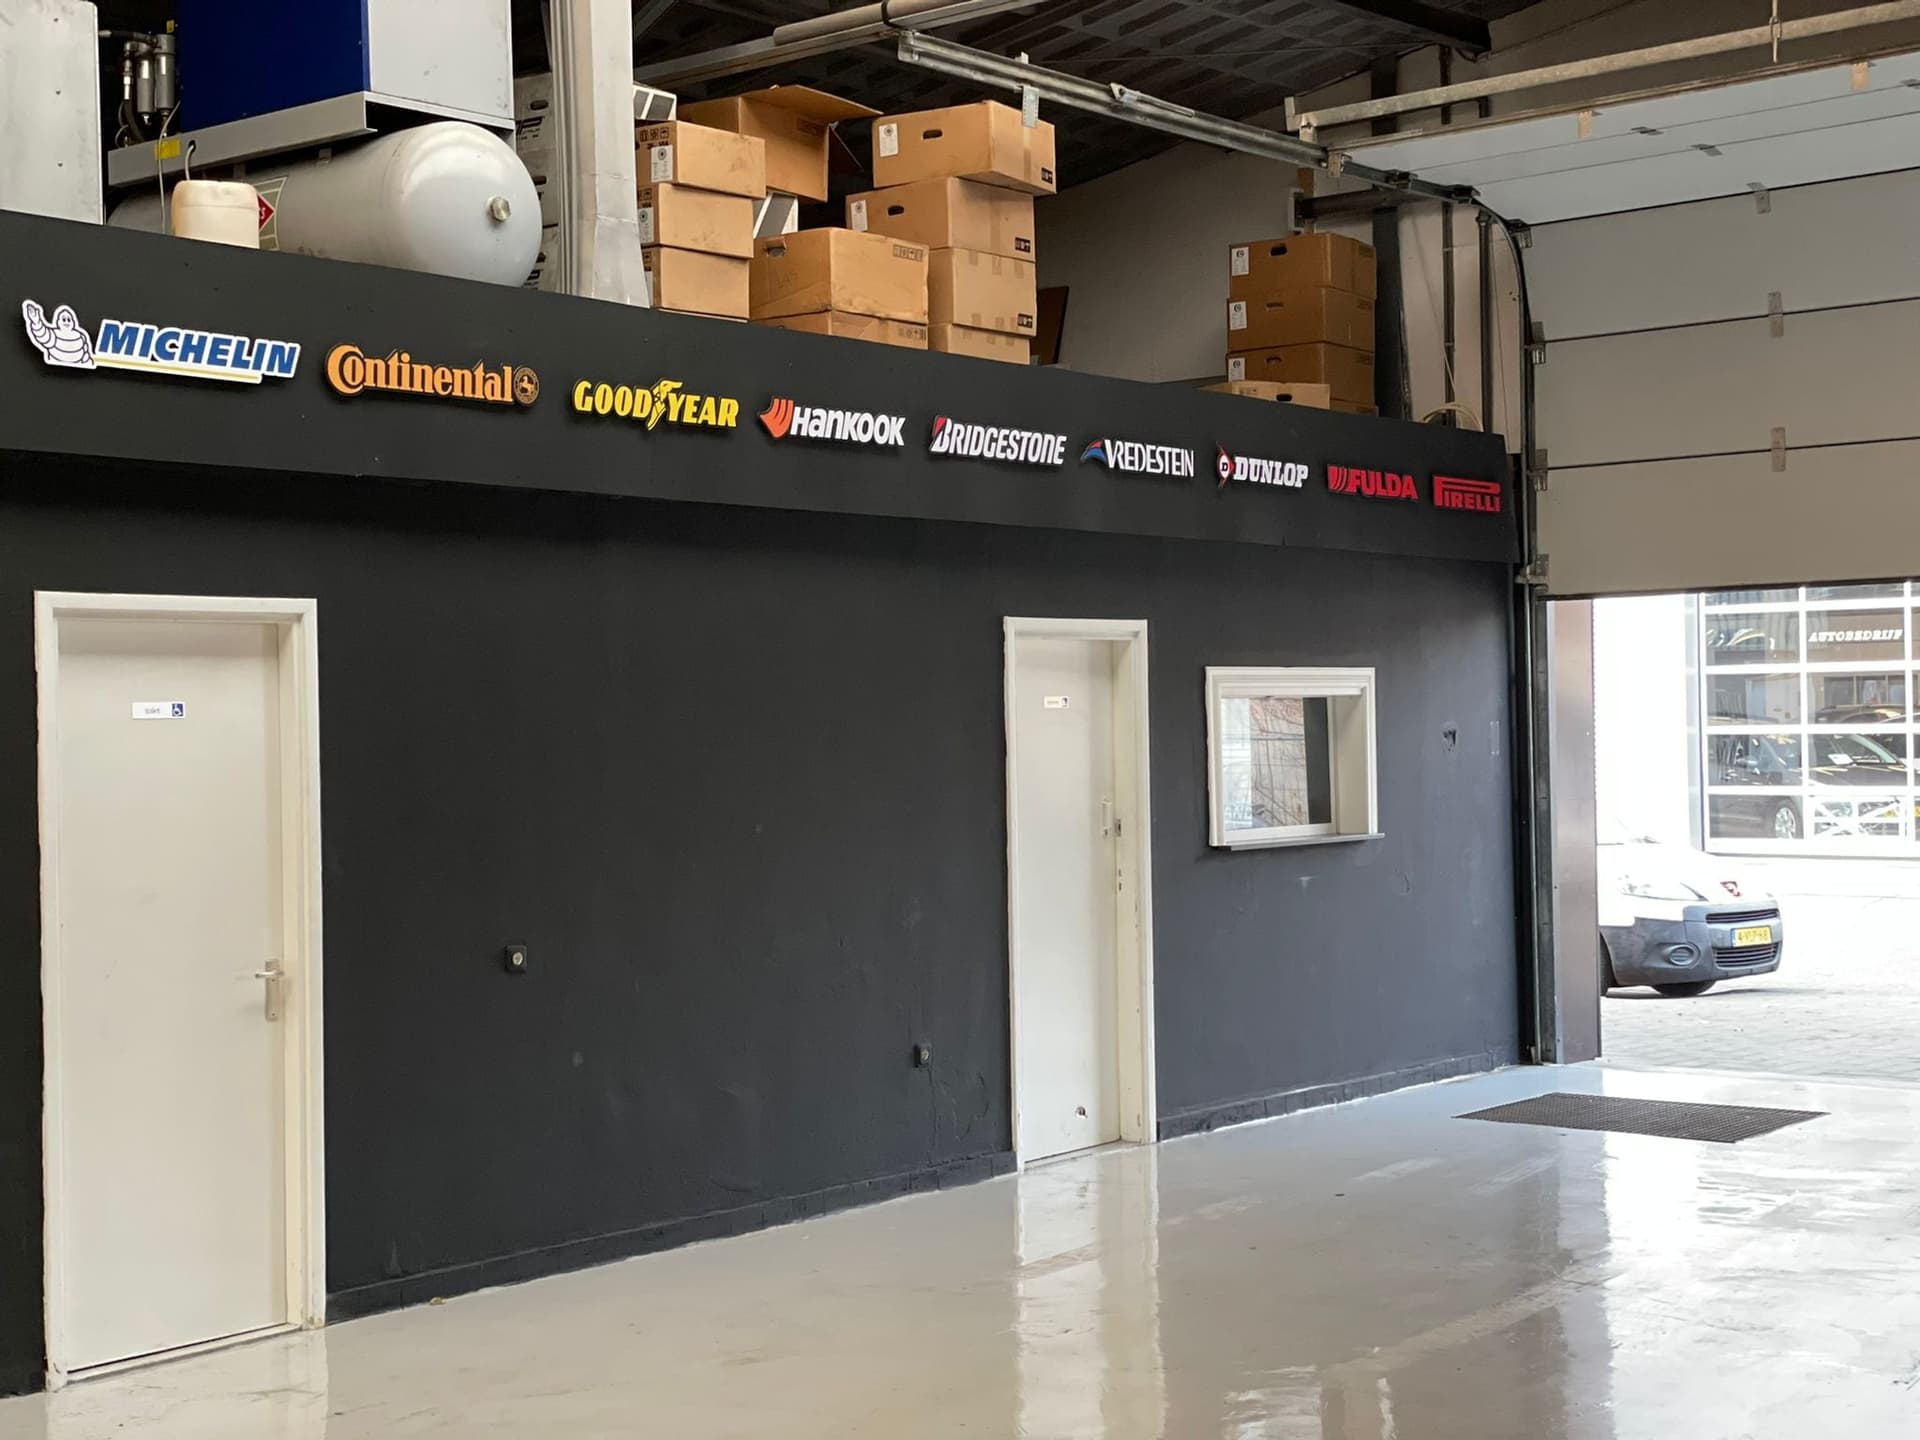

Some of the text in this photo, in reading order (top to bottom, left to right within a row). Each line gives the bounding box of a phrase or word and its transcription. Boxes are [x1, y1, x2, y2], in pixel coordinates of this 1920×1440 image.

[98, 322, 298, 375] MICHELIN
[327, 344, 513, 402] Continental
[573, 379, 739, 430] GOODYEAR
[930, 417, 1067, 465] BRIDGESTONE
[1103, 439, 1195, 478] VREDESTEIN
[1233, 455, 1309, 488] DUNLOP
[1346, 468, 1418, 500] FULDA
[1433, 475, 1500, 512] PIRELLI
[1808, 629, 1903, 642] AUTOBEDRIJF
